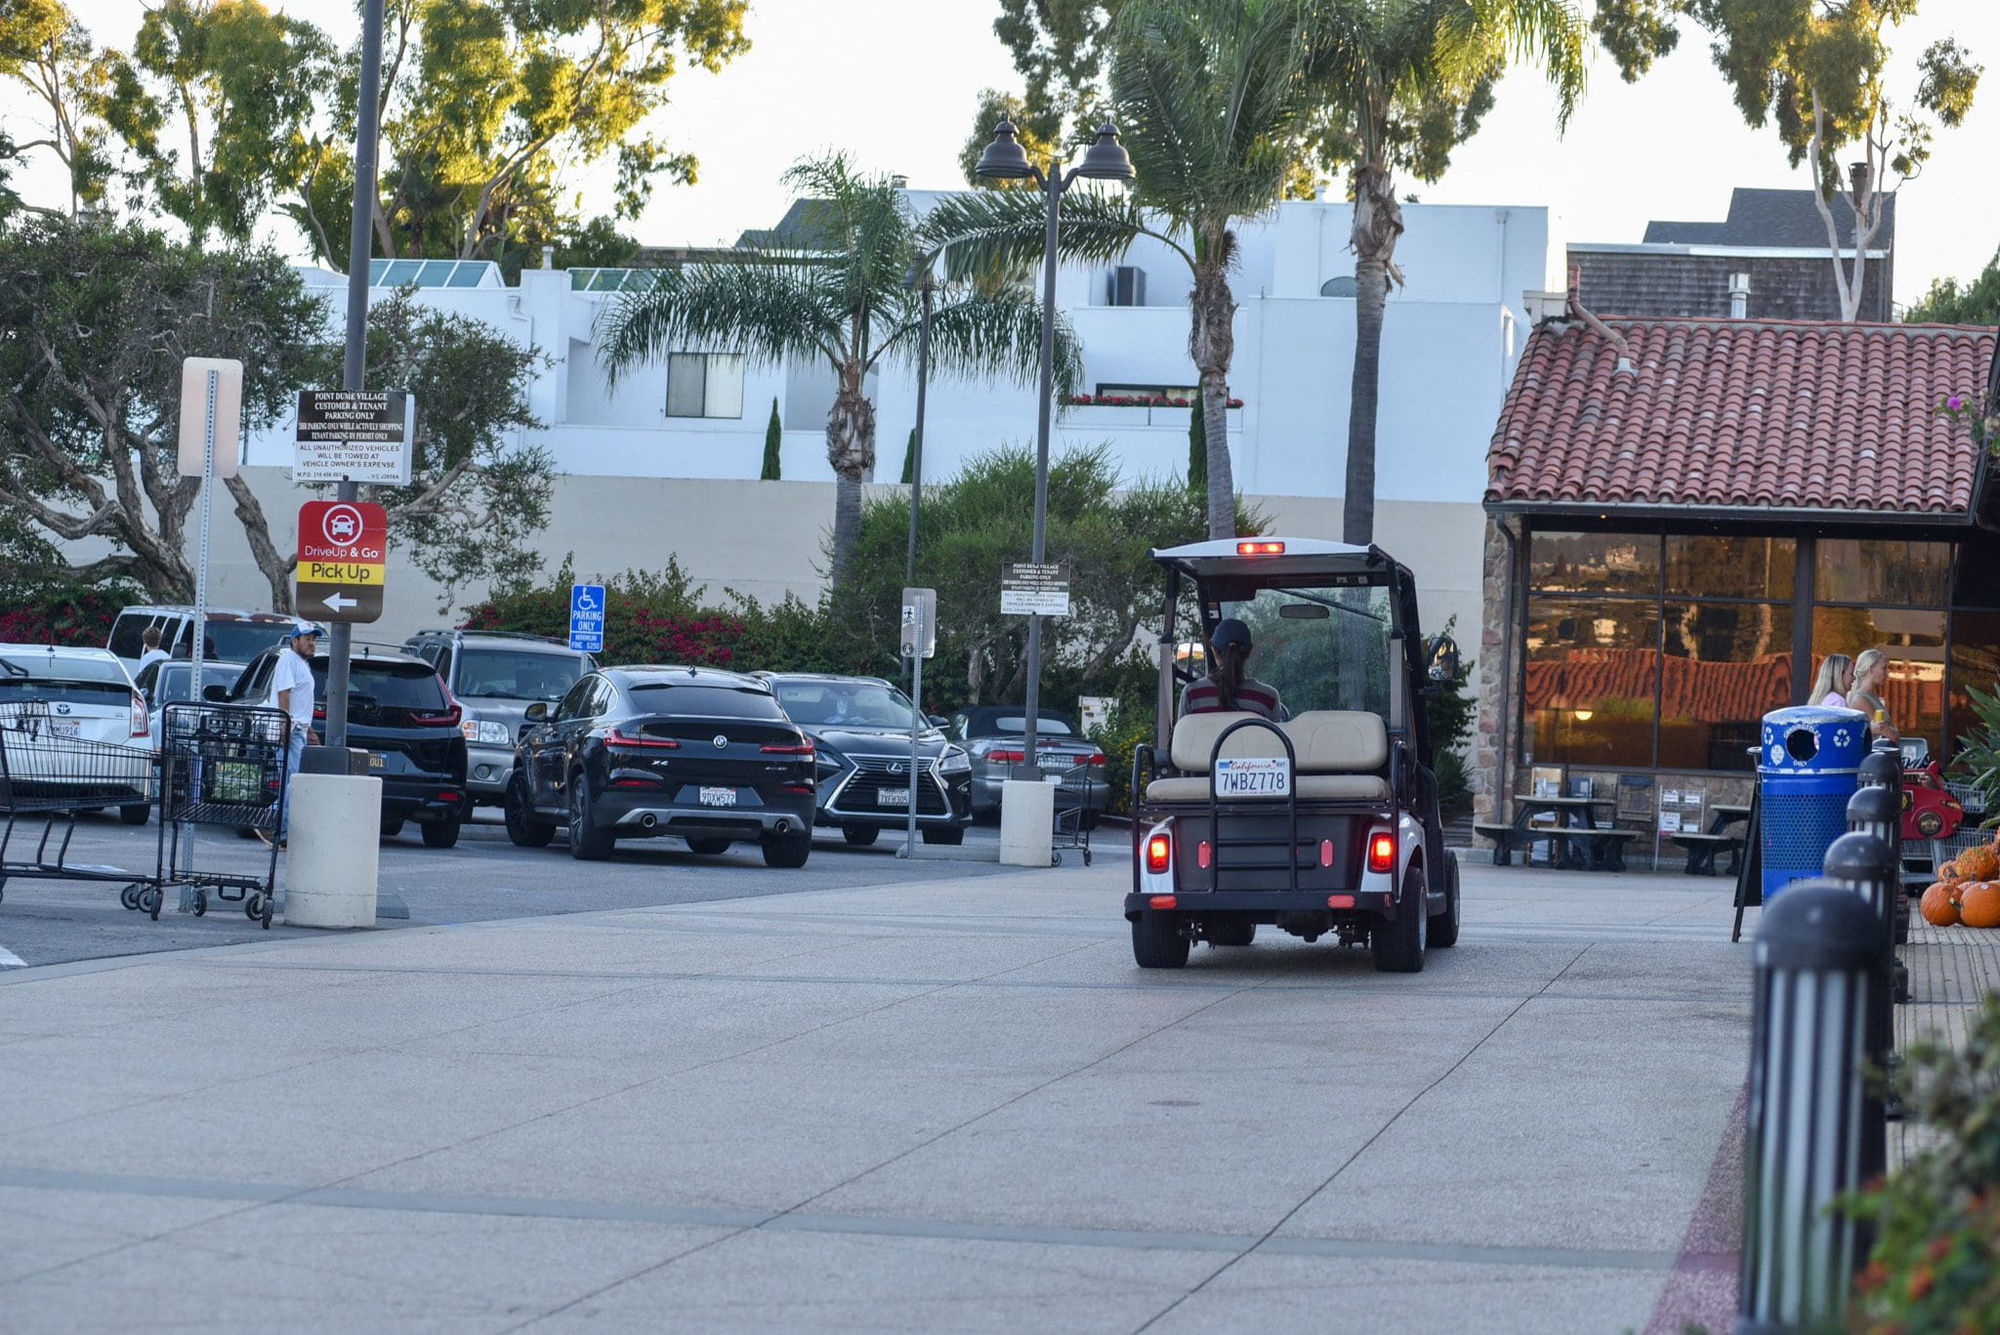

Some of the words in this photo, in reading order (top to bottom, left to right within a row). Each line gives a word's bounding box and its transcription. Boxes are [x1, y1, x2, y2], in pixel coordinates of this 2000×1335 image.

[315, 392, 334, 400] POINT
[336, 392, 354, 400] DUME
[356, 392, 388, 400] VILLAGE
[379, 423, 403, 431] SHOPPING
[305, 546, 347, 559] DriveUp
[350, 547, 358, 558] &
[362, 548, 378, 558] Go
[312, 563, 343, 578] Pick
[348, 565, 370, 582] Up
[572, 610, 602, 621] PARKING
[578, 621, 595, 630] ONLY
[1230, 760, 1272, 771] California
[1221, 773, 1284, 790] 7WBZ778
